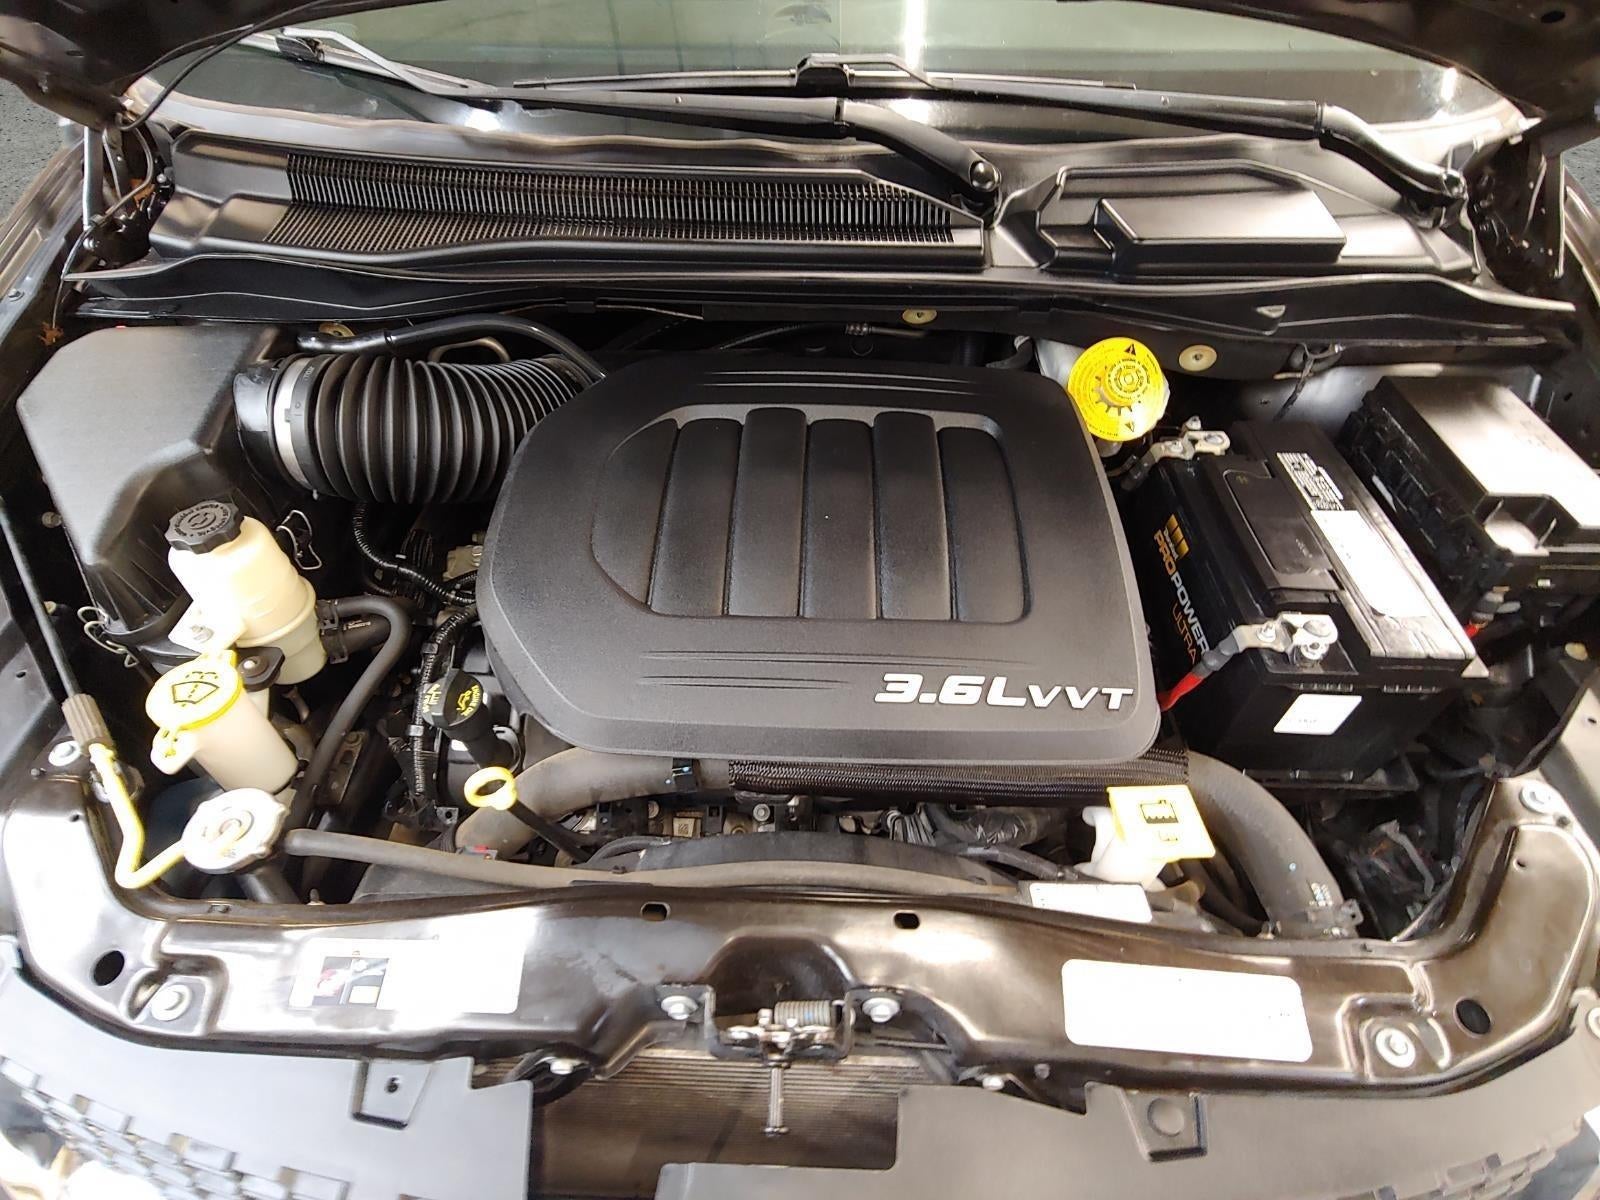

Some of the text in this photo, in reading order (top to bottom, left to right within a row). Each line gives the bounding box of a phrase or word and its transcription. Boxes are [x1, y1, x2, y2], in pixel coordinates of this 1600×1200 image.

[1172, 602, 1197, 665] ULTRA
[874, 673, 1134, 710] 3.6L VVT
